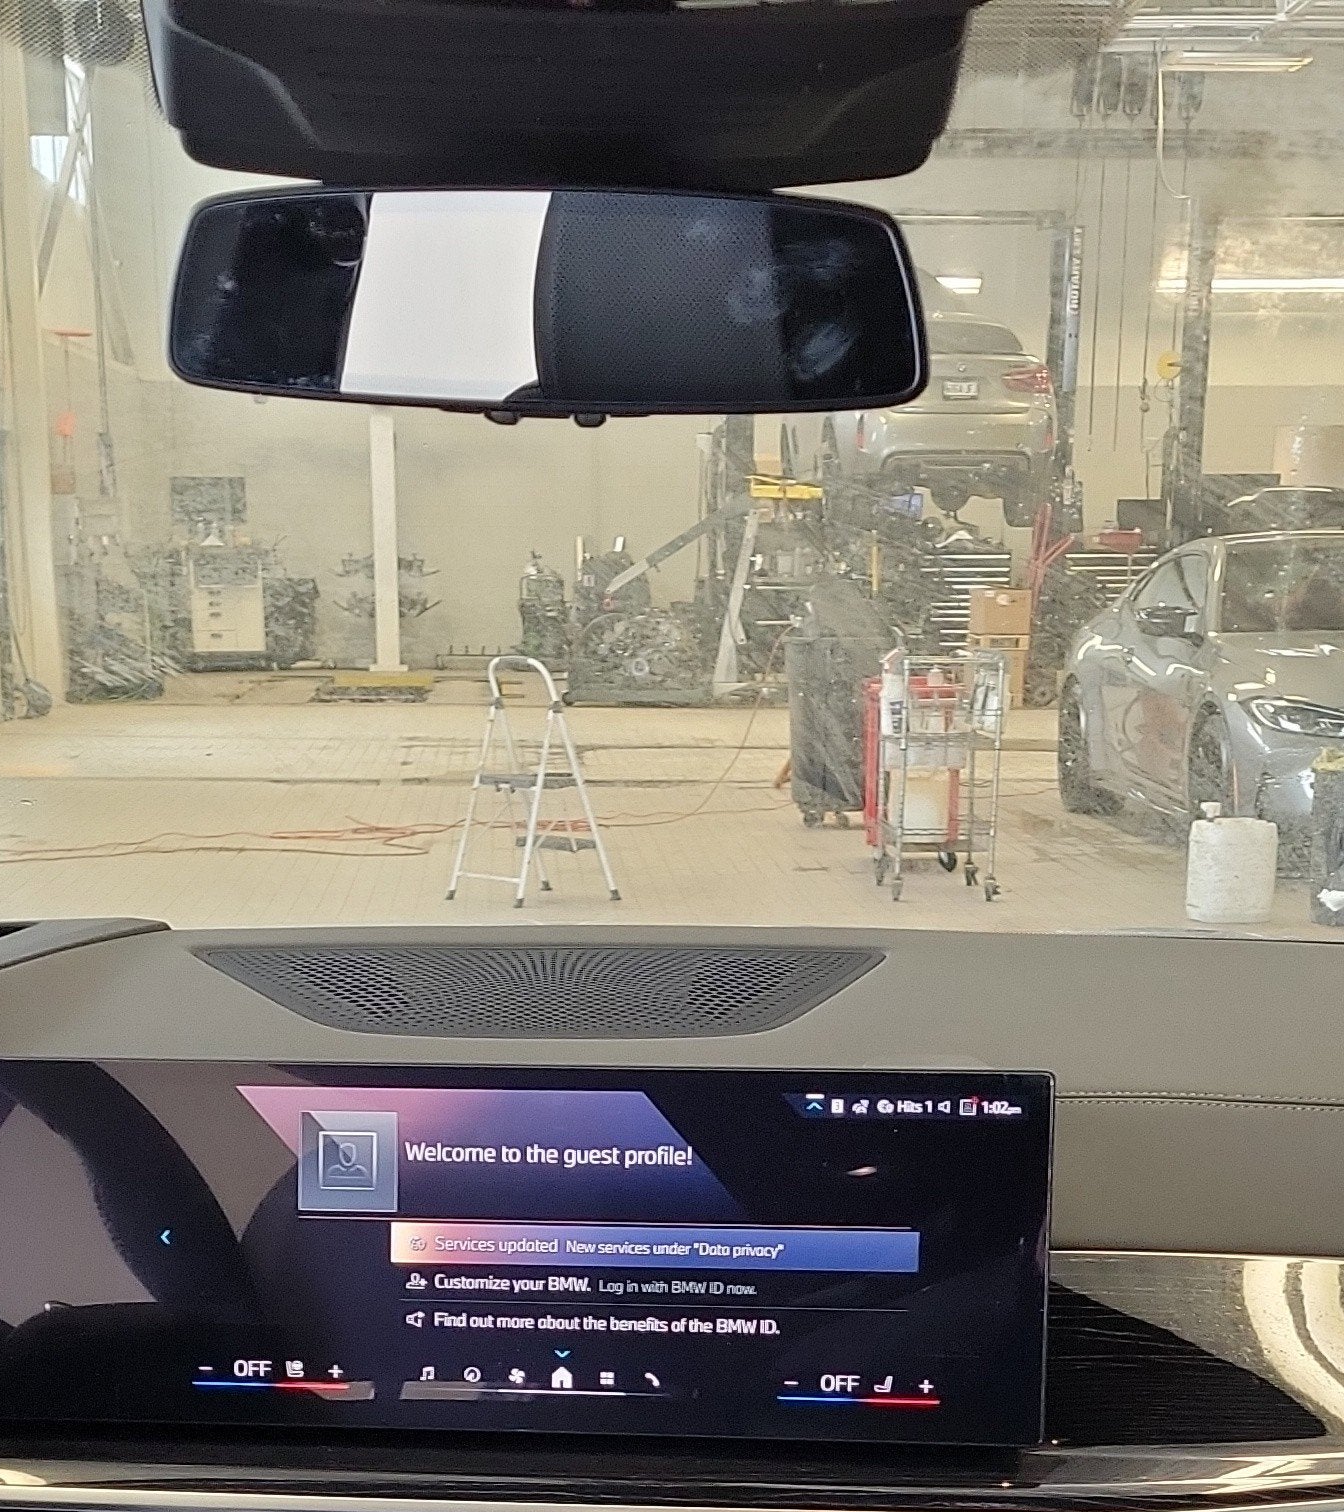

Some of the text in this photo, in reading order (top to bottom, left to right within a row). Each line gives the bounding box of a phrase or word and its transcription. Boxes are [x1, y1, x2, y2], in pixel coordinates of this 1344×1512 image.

[405, 1142, 693, 1168] Welcome to the guest profile!
[435, 1236, 784, 1259] Services updated New services under "Data privacy"
[434, 1274, 757, 1295] Customize your BMW. Log in with BMW ID now.
[434, 1312, 780, 1335] Find out more about the benefits of the BMW ID.
[233, 1359, 272, 1377] OFF
[820, 1374, 861, 1392] OFF
